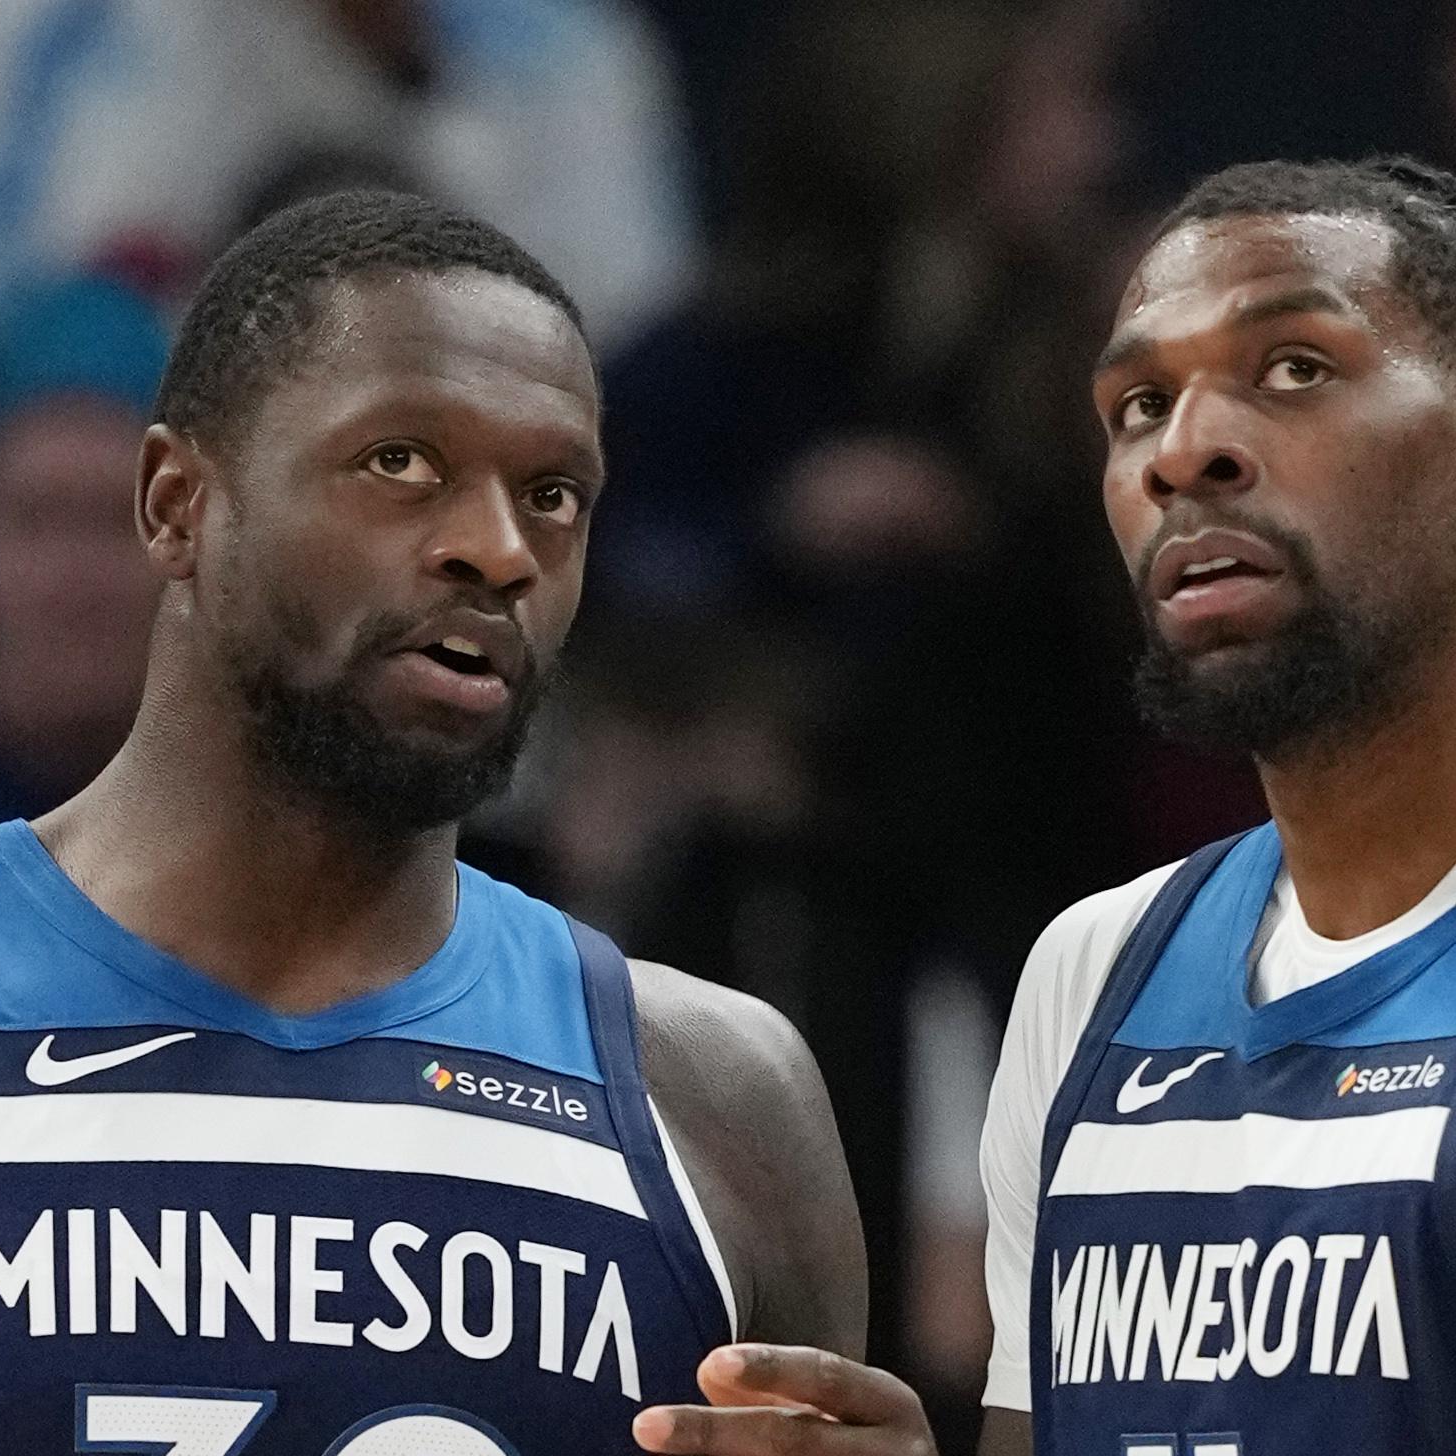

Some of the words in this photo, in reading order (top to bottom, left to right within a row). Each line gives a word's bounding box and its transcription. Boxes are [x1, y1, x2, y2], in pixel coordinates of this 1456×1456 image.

[455, 1071, 588, 1122] sezzle
[1352, 1054, 1446, 1094] sezzle
[1050, 1234, 1410, 1390] MINNESOTA
